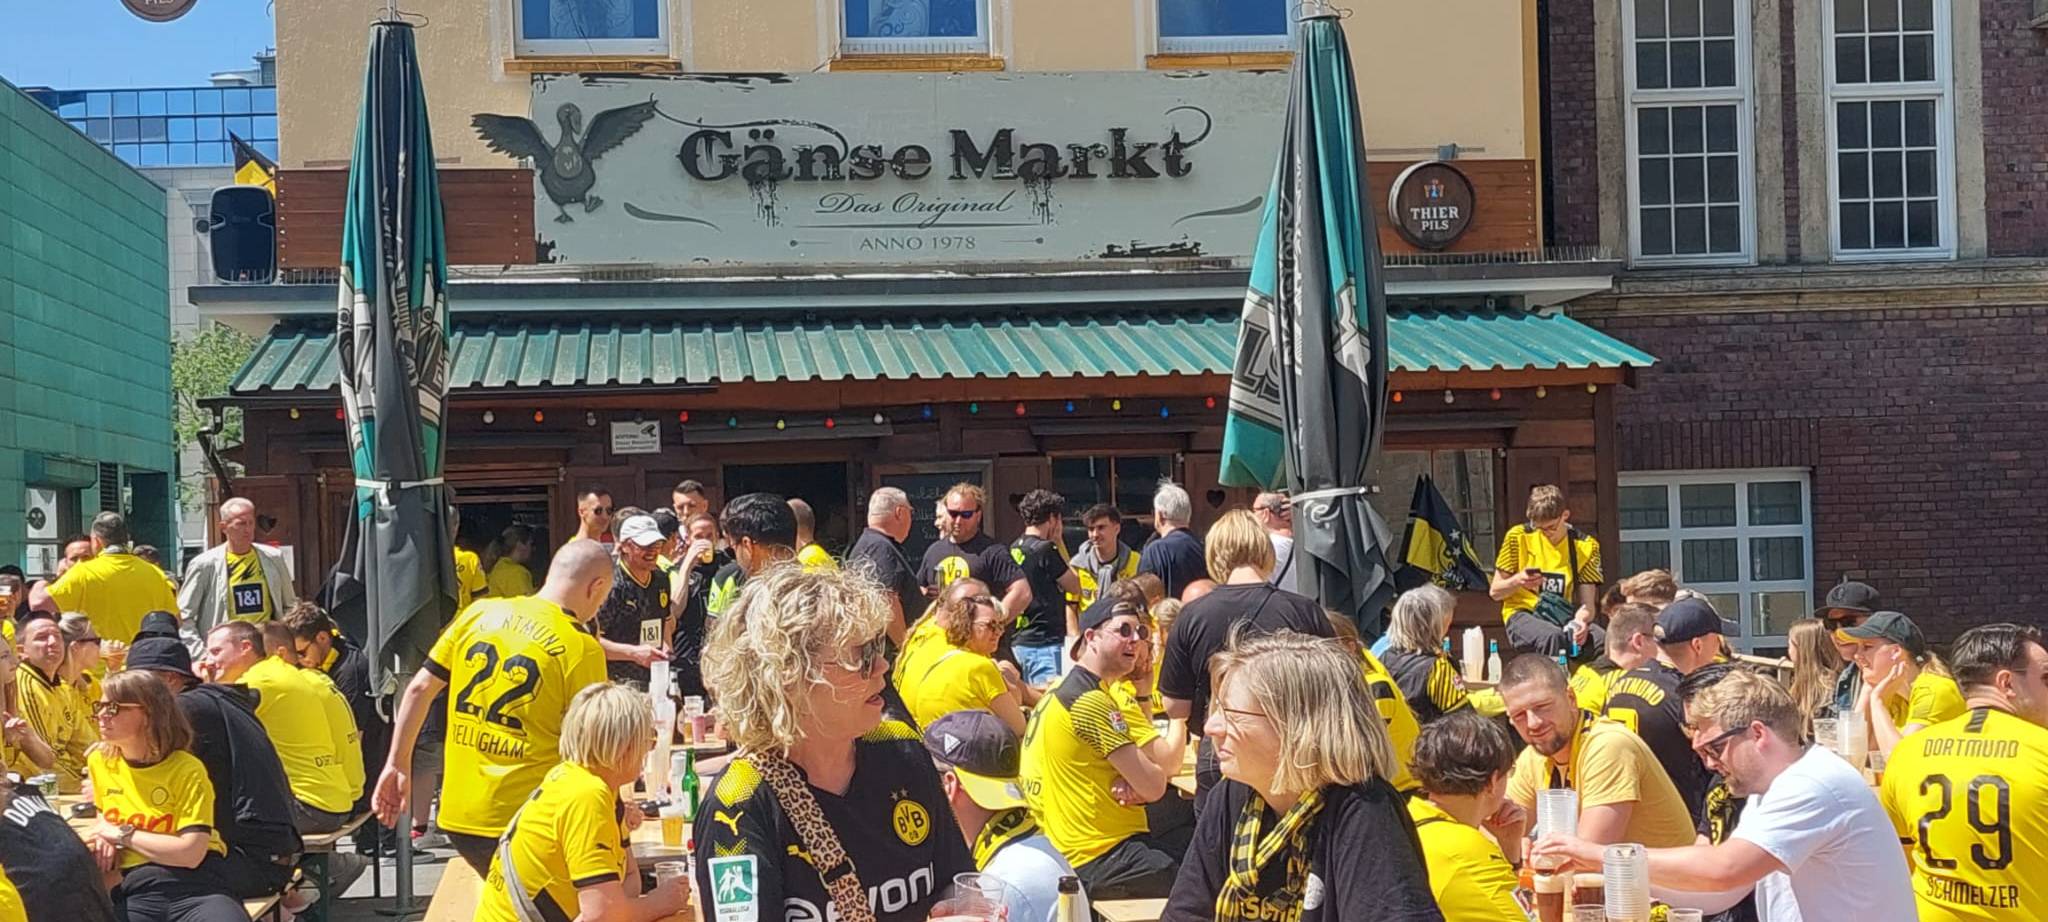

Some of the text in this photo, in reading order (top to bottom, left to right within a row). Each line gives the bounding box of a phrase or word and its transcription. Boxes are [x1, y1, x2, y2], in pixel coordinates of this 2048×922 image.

[677, 106, 1212, 182] Gänse Markt
[816, 190, 1016, 229] Das Original
[1410, 206, 1459, 219] THIER
[1421, 220, 1449, 231] PILS
[859, 236, 976, 251] ANNO 1978
[235, 590, 262, 607] 1&1
[643, 626, 659, 641] 1&1
[456, 640, 542, 732] 22
[1923, 738, 2019, 759] DORTMUND
[897, 804, 924, 834] BVB
[1919, 773, 2013, 871] 29
[1926, 875, 2019, 909] SCHMELZER
